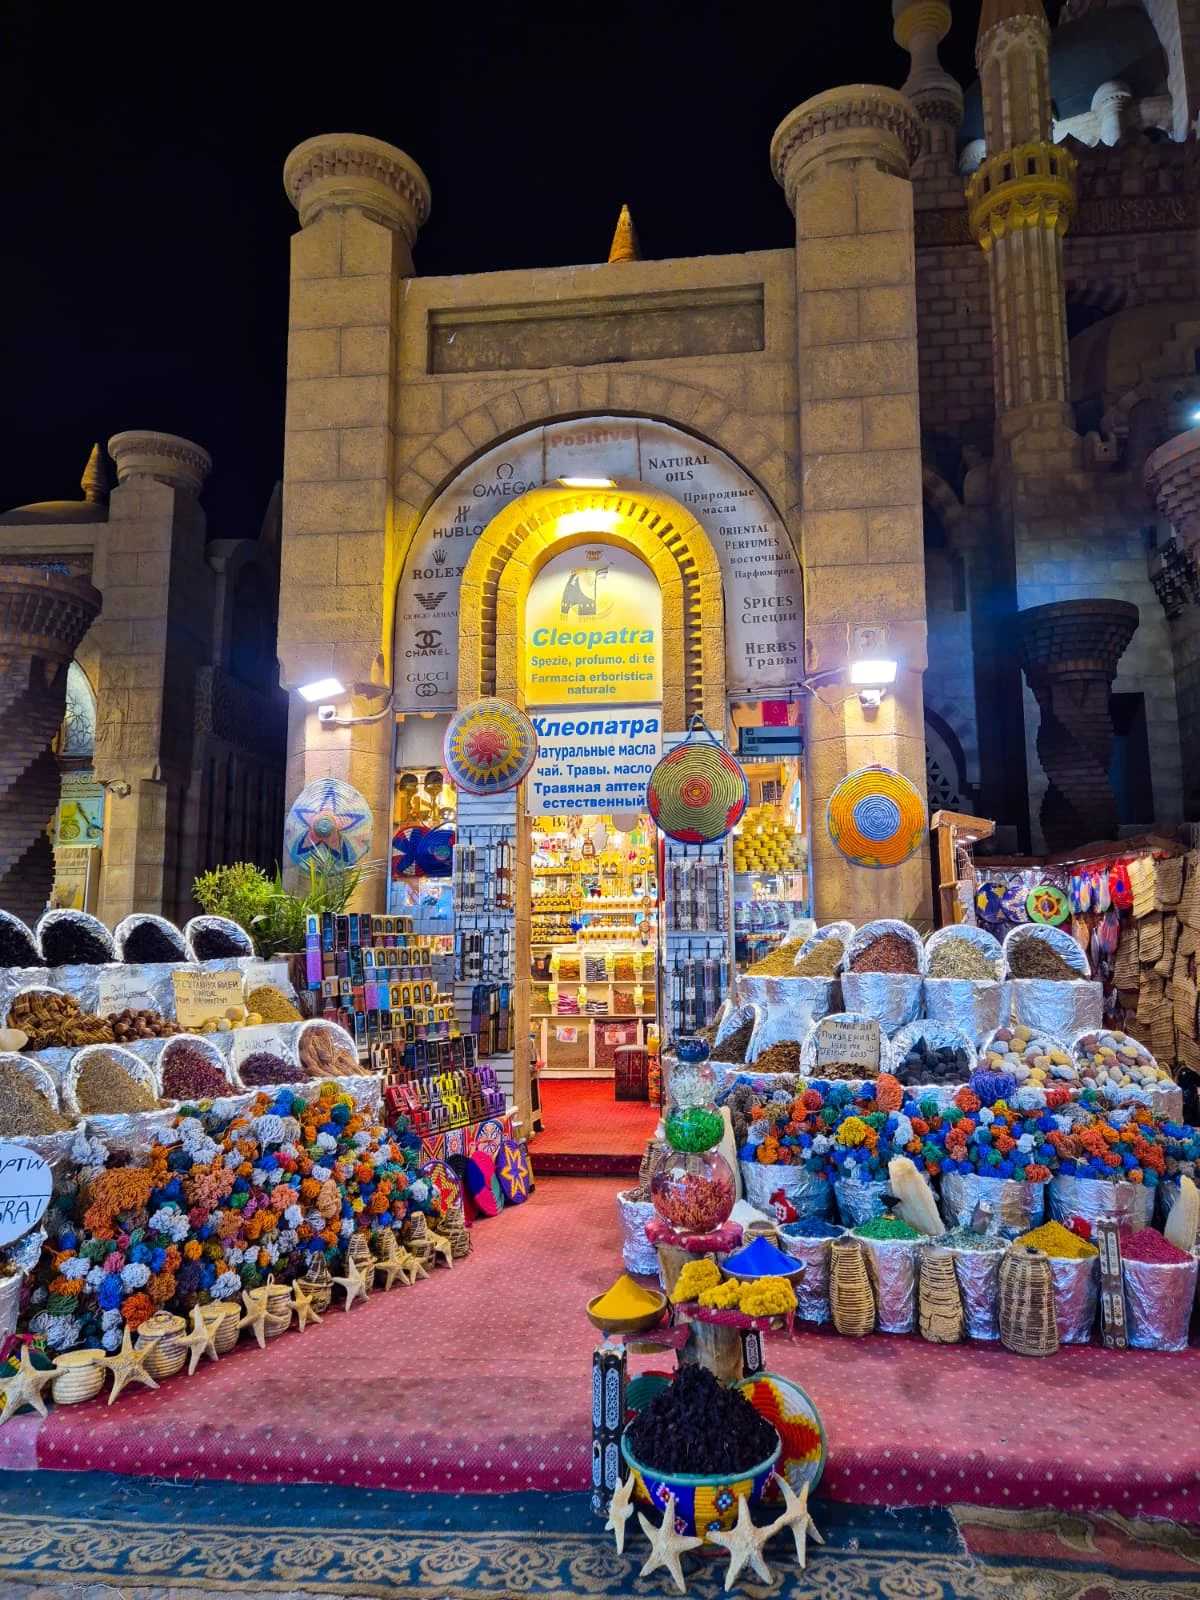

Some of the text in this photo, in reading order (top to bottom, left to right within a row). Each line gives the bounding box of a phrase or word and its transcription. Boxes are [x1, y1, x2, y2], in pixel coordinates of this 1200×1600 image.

[648, 455, 710, 470] NATURAL
[472, 481, 537, 498] OMEGA
[683, 489, 755, 503] Природные
[702, 505, 736, 515] масла
[719, 524, 769, 536] ORIENTAL
[725, 538, 780, 550] PERFUMES
[730, 551, 791, 564] восточный
[743, 595, 793, 610] SPICES
[741, 612, 797, 624] Специи
[532, 626, 654, 649] Cleopatra
[405, 648, 451, 658] CHANEL
[745, 641, 797, 655] HERBS
[531, 652, 655, 668] Spezie, profumo. di te
[745, 656, 797, 670] Травы
[406, 671, 449, 682] GUCCI
[531, 671, 653, 683] Farmacia erboristica
[567, 684, 616, 695] naturale
[533, 717, 659, 739] Клеопатра
[618, 743, 656, 756] масла
[537, 763, 652, 777] чай. Травы. масло
[534, 781, 648, 796] Травяная аптек
[543, 794, 645, 808] естественный
